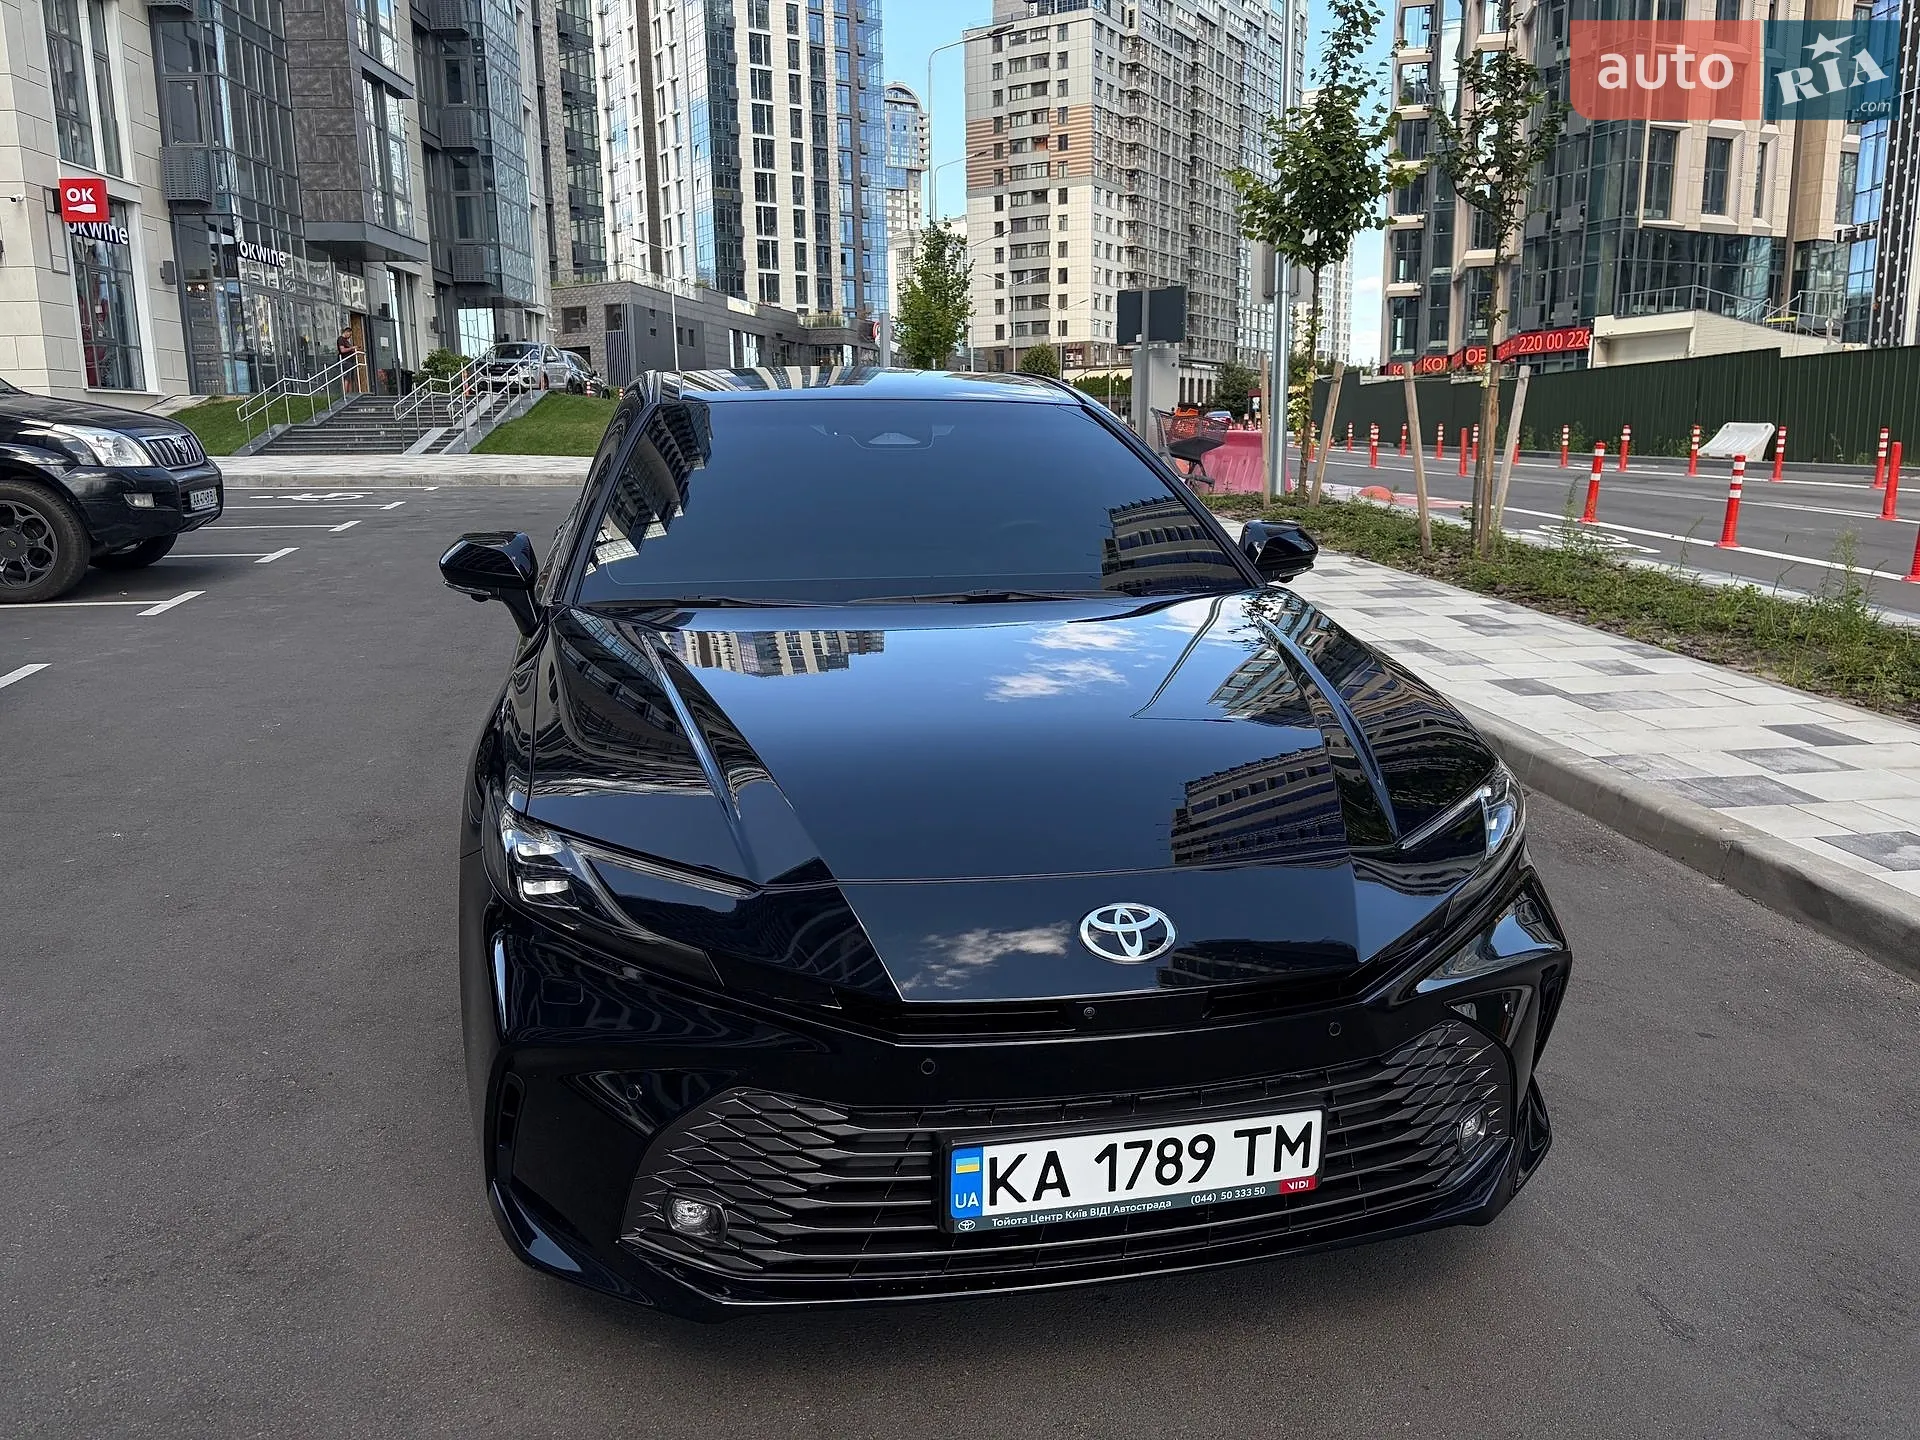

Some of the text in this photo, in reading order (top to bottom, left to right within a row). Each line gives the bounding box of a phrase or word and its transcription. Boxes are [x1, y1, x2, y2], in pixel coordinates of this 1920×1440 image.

[66, 187, 96, 203] OK
[1518, 334, 1543, 353] 220
[1546, 333, 1563, 350] 00
[988, 1121, 1313, 1206] KA 1789 TM
[1286, 1179, 1310, 1190] VIDI
[955, 1193, 979, 1209] UA
[1190, 1186, 1266, 1206] (044) 50 333 50
[992, 1217, 1028, 1227] Тойота
[1030, 1212, 1062, 1224] Центр
[1065, 1209, 1088, 1219] Київ
[1113, 1200, 1172, 1214] Автострада
